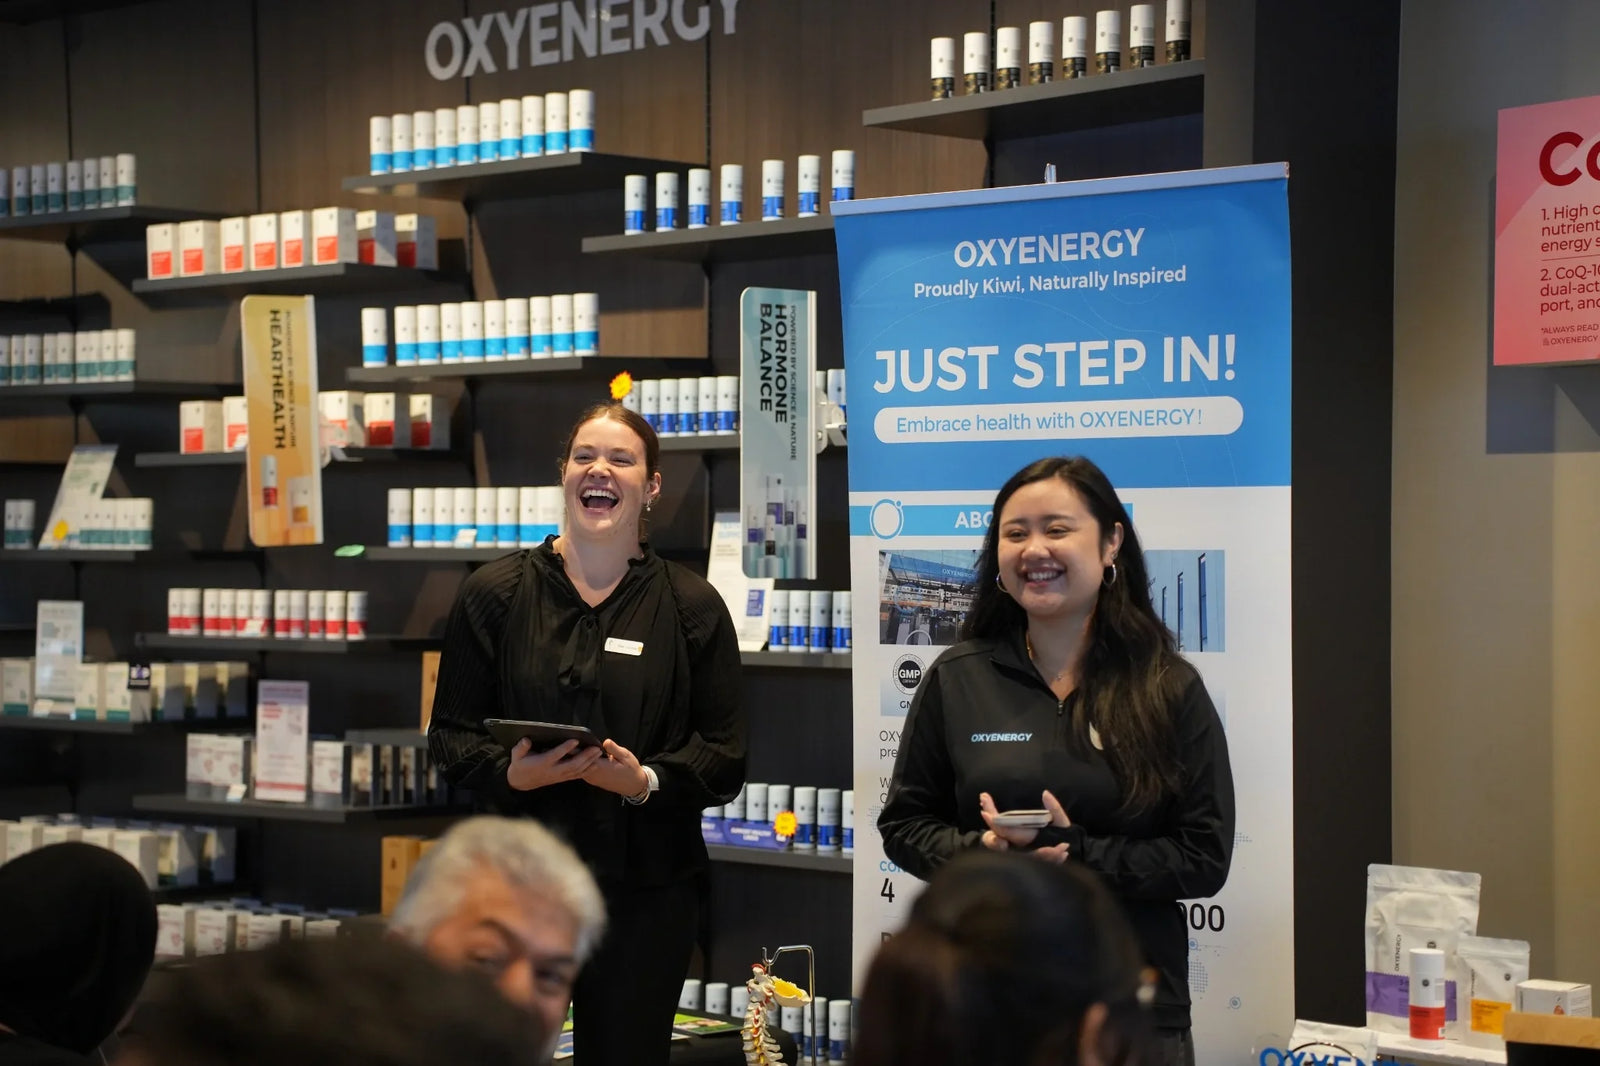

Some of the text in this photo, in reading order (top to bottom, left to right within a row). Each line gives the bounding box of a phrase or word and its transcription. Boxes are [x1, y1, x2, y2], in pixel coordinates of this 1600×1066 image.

[424, 0, 739, 81] OXYENERGY
[1541, 208, 1550, 221] 1.
[1554, 203, 1589, 222] High
[954, 227, 1145, 268] OXYENERGY
[1541, 237, 1593, 253] energy
[914, 264, 1187, 299] Proudly Kiwi, Naturally Inspired
[1540, 268, 1552, 281] 2.
[1540, 281, 1600, 297] dual-act
[1540, 299, 1574, 316] port,
[1576, 323, 1600, 332] READ
[1550, 335, 1599, 345] OXYENERGY
[760, 303, 772, 412] BALANCE
[775, 303, 787, 424] HORMONE
[873, 334, 1236, 394] JUST STEP IN!
[270, 309, 286, 450] HEARTHEALTH
[896, 416, 972, 433] Embrace
[976, 413, 1031, 431] health
[1036, 412, 1075, 429] with
[899, 669, 921, 680] GMP
[970, 733, 1033, 743] OXYENERGY
[880, 877, 896, 903] 4
